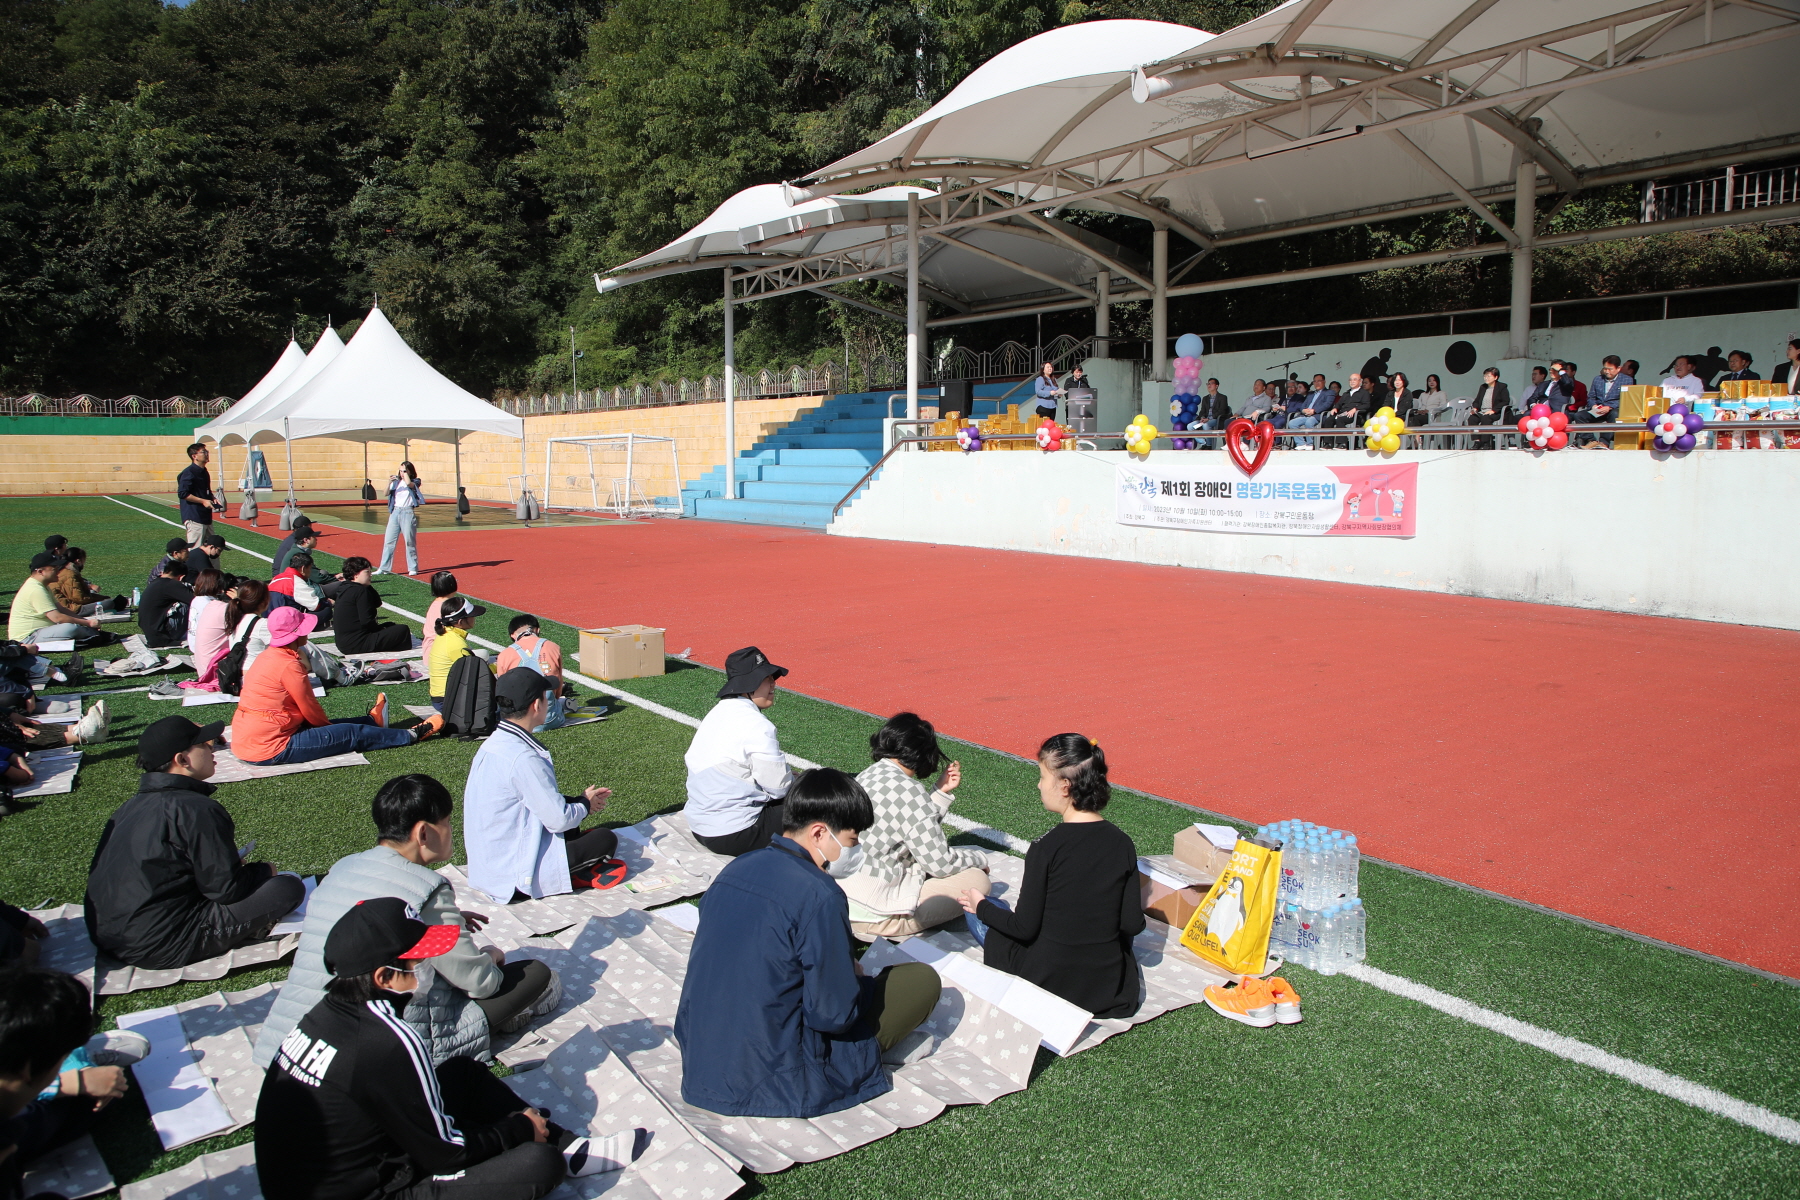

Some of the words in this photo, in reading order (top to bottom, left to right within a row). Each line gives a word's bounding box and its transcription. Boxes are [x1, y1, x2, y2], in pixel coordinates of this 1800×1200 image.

[1160, 480, 1191, 497] 제1회
[1194, 481, 1232, 499] 장애인
[1236, 482, 1337, 500] 명랑가족운동회
[1153, 505, 1172, 514] 2023년
[1173, 507, 1186, 515] 10월
[1281, 875, 1304, 891] SEOK
[1297, 929, 1321, 944] SEOK
[299, 1038, 338, 1080] FA
[289, 1064, 321, 1088] Fitness
